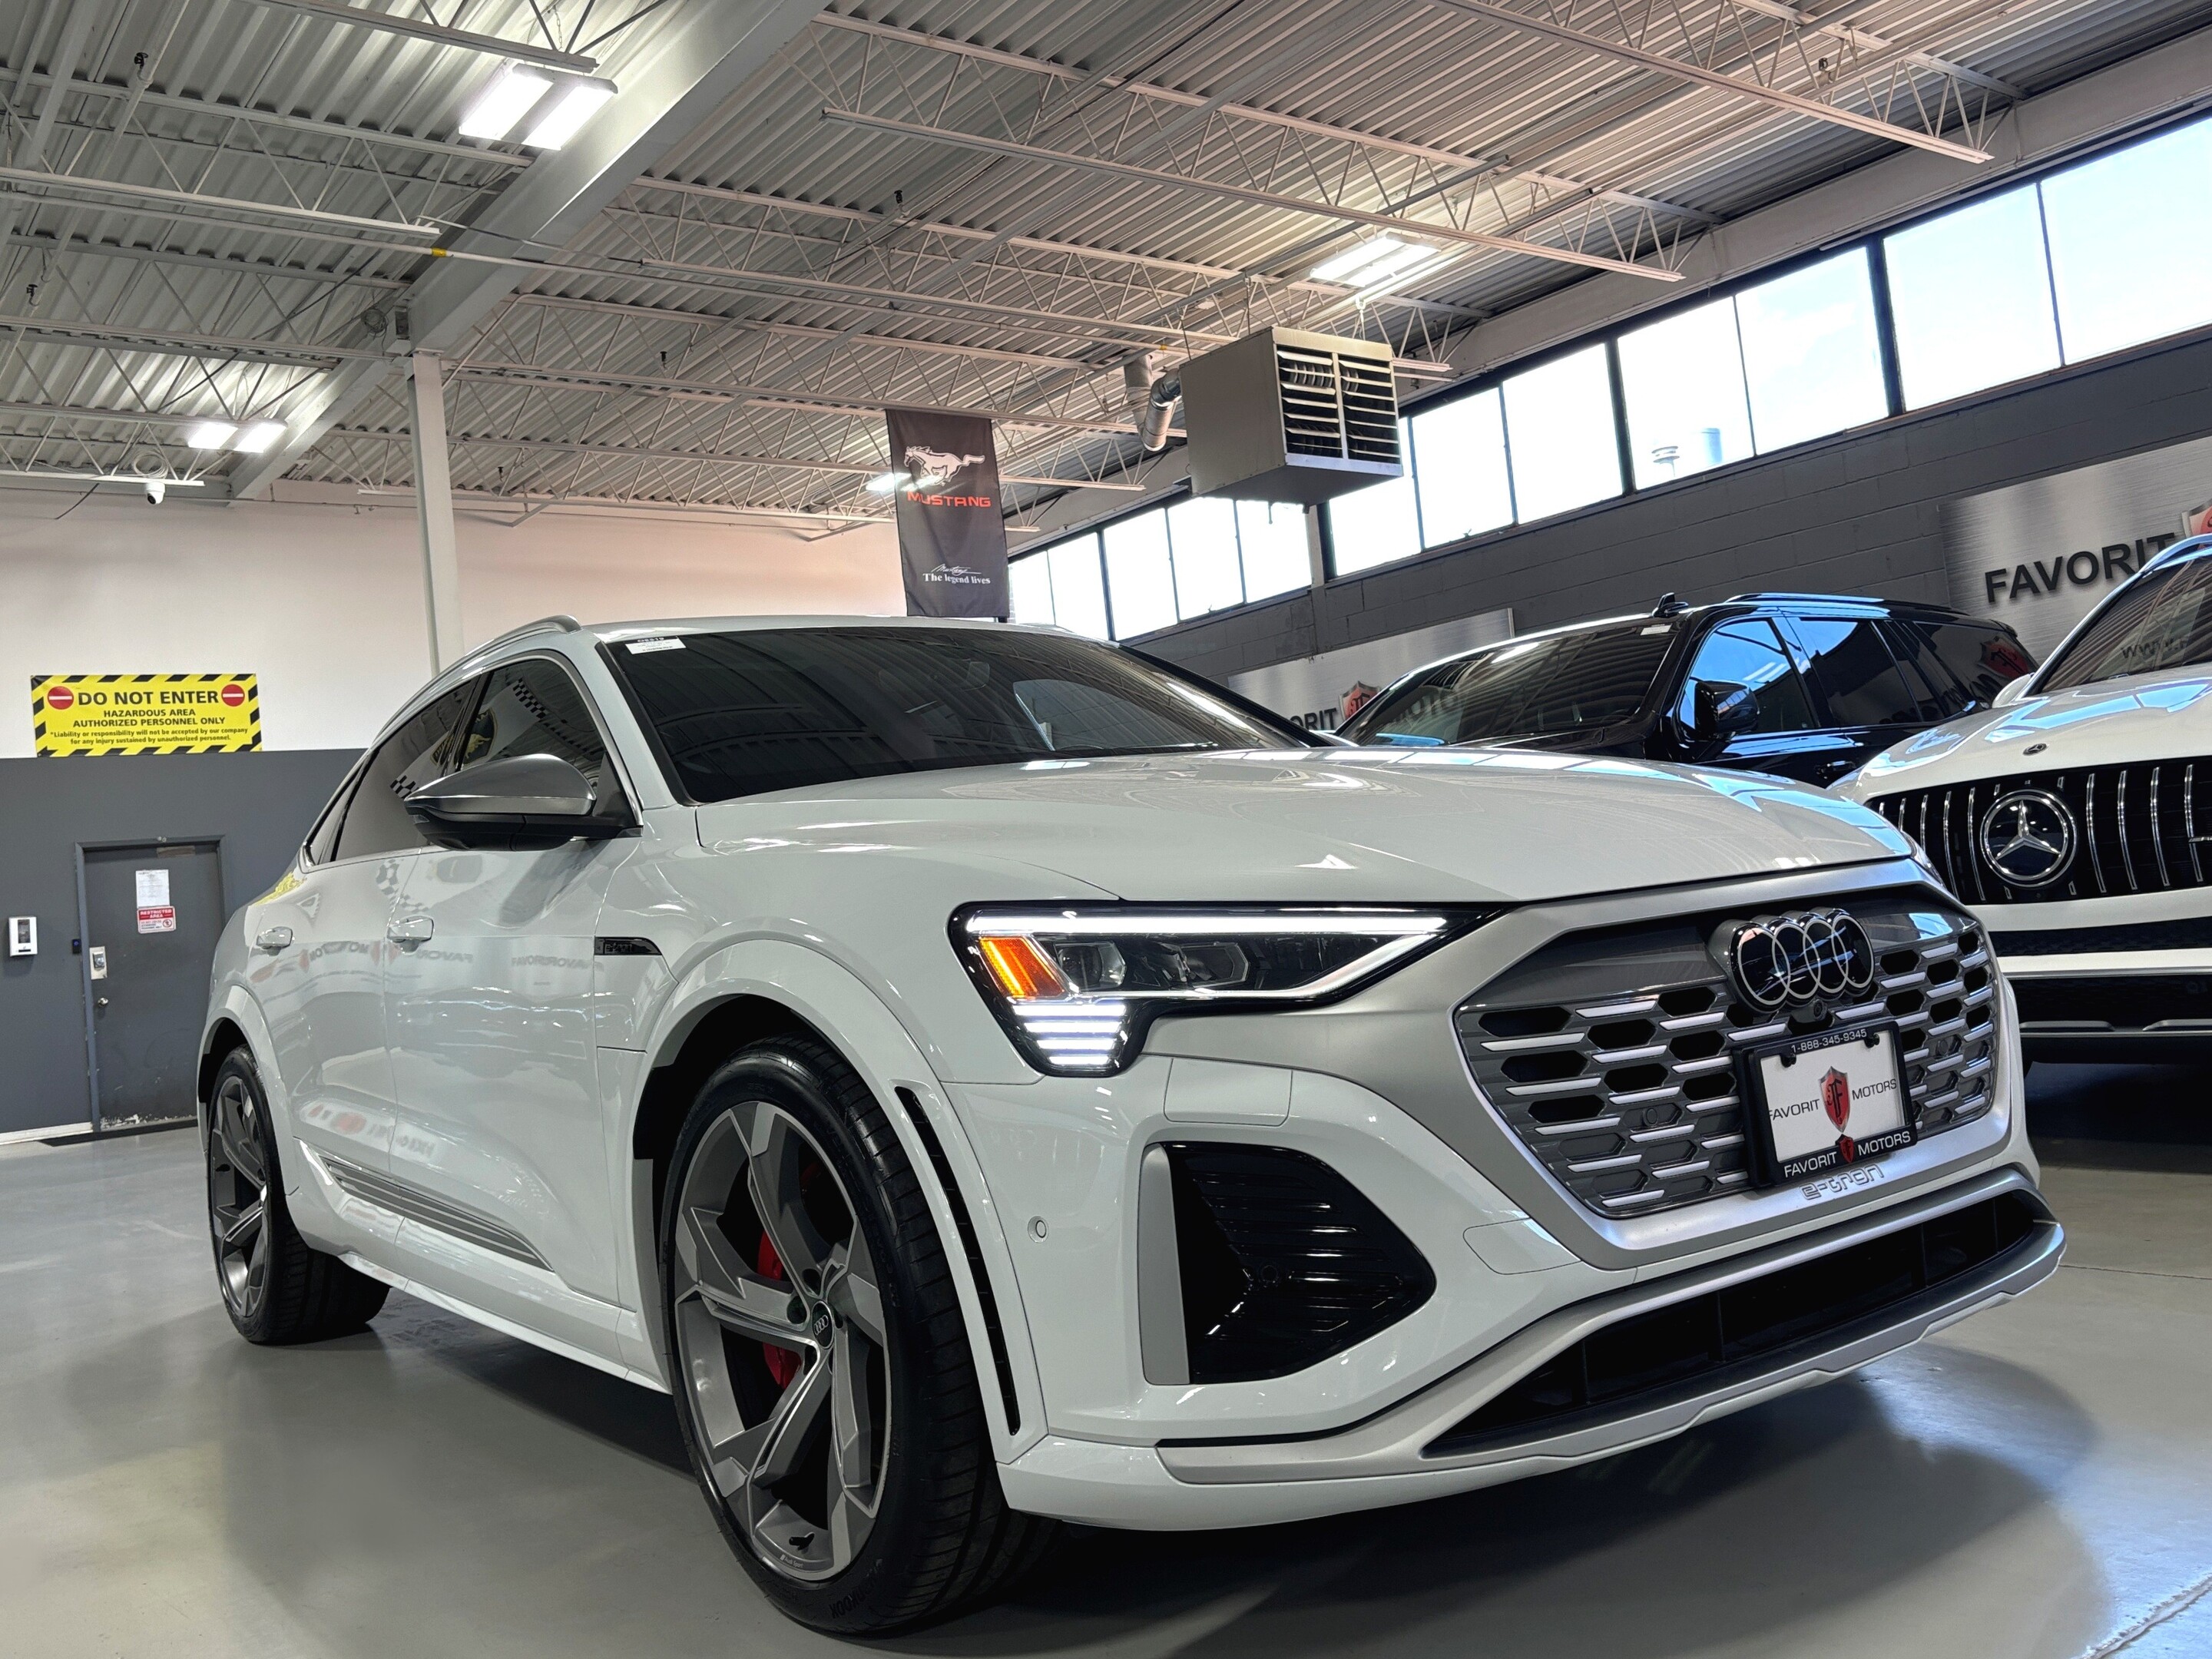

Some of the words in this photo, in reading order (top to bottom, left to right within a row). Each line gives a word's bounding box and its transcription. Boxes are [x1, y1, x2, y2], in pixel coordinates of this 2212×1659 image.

[907, 491, 991, 507] MUSTANG
[922, 573, 942, 581] The
[944, 573, 969, 584] legend
[971, 575, 991, 584] lives
[78, 692, 108, 705] DO
[114, 691, 154, 704] NOT
[160, 690, 219, 704] ENTER
[104, 709, 166, 717] HAZARDOUS
[170, 708, 196, 717] AREA
[73, 719, 137, 727] AUTHORIZED
[141, 717, 198, 726] PERSONNEL
[200, 717, 226, 725] ONLY
[1791, 1028, 1867, 1053] 1-888-345-9345
[1852, 1078, 1897, 1101] MOTORS
[1784, 1151, 1837, 1178] FAVORIT
[1857, 1131, 1911, 1156] MOTORS
[1799, 1164, 1885, 1200] e-tron
